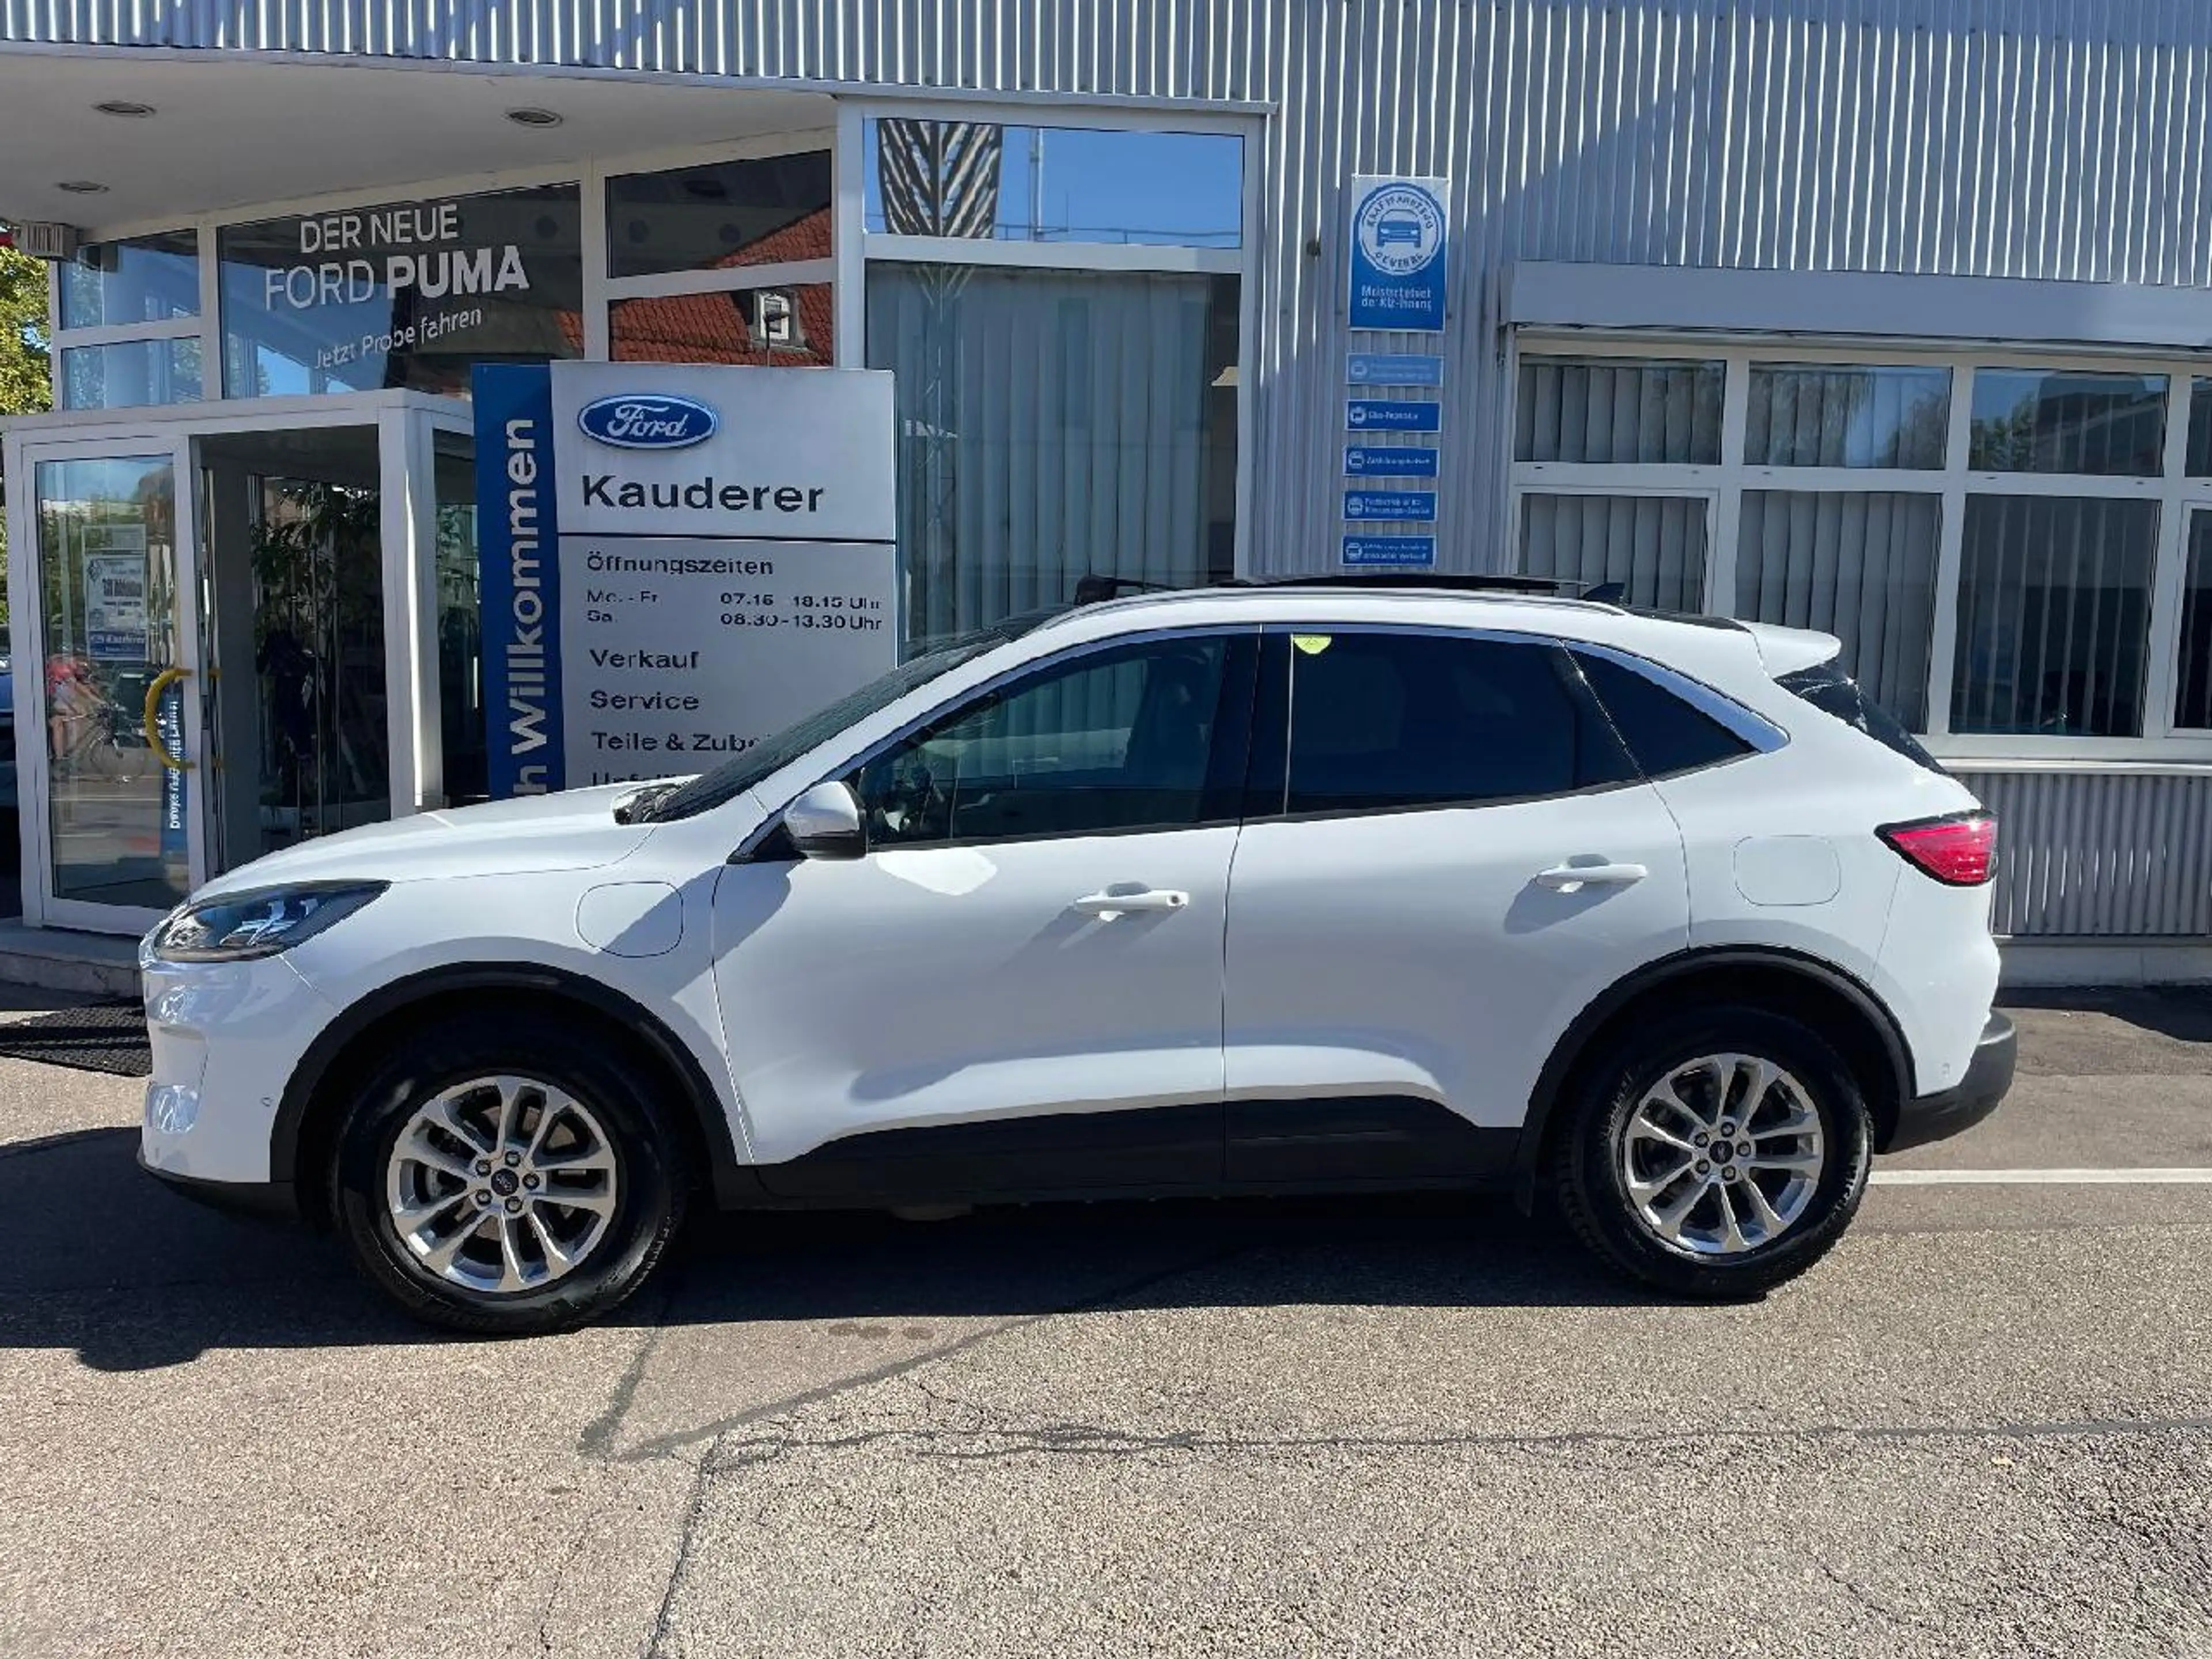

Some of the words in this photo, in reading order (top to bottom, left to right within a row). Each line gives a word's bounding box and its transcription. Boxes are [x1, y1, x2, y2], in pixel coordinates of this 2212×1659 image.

[300, 215, 362, 253] DER
[370, 203, 459, 244] NEUE
[264, 259, 374, 311] FORD
[386, 245, 529, 298] PUMA
[315, 342, 358, 369] Jetzt
[362, 325, 415, 357] Probe
[420, 307, 483, 344] fahren
[607, 403, 689, 437] Ford
[582, 475, 824, 513] Kauderer
[587, 550, 774, 575] Öffnungszeiten
[506, 419, 548, 755] Willkommen
[850, 615, 882, 630] Uhr
[589, 649, 700, 669] Verkauf
[590, 690, 699, 710] Service
[591, 732, 658, 751] Teile
[665, 733, 685, 751] &
